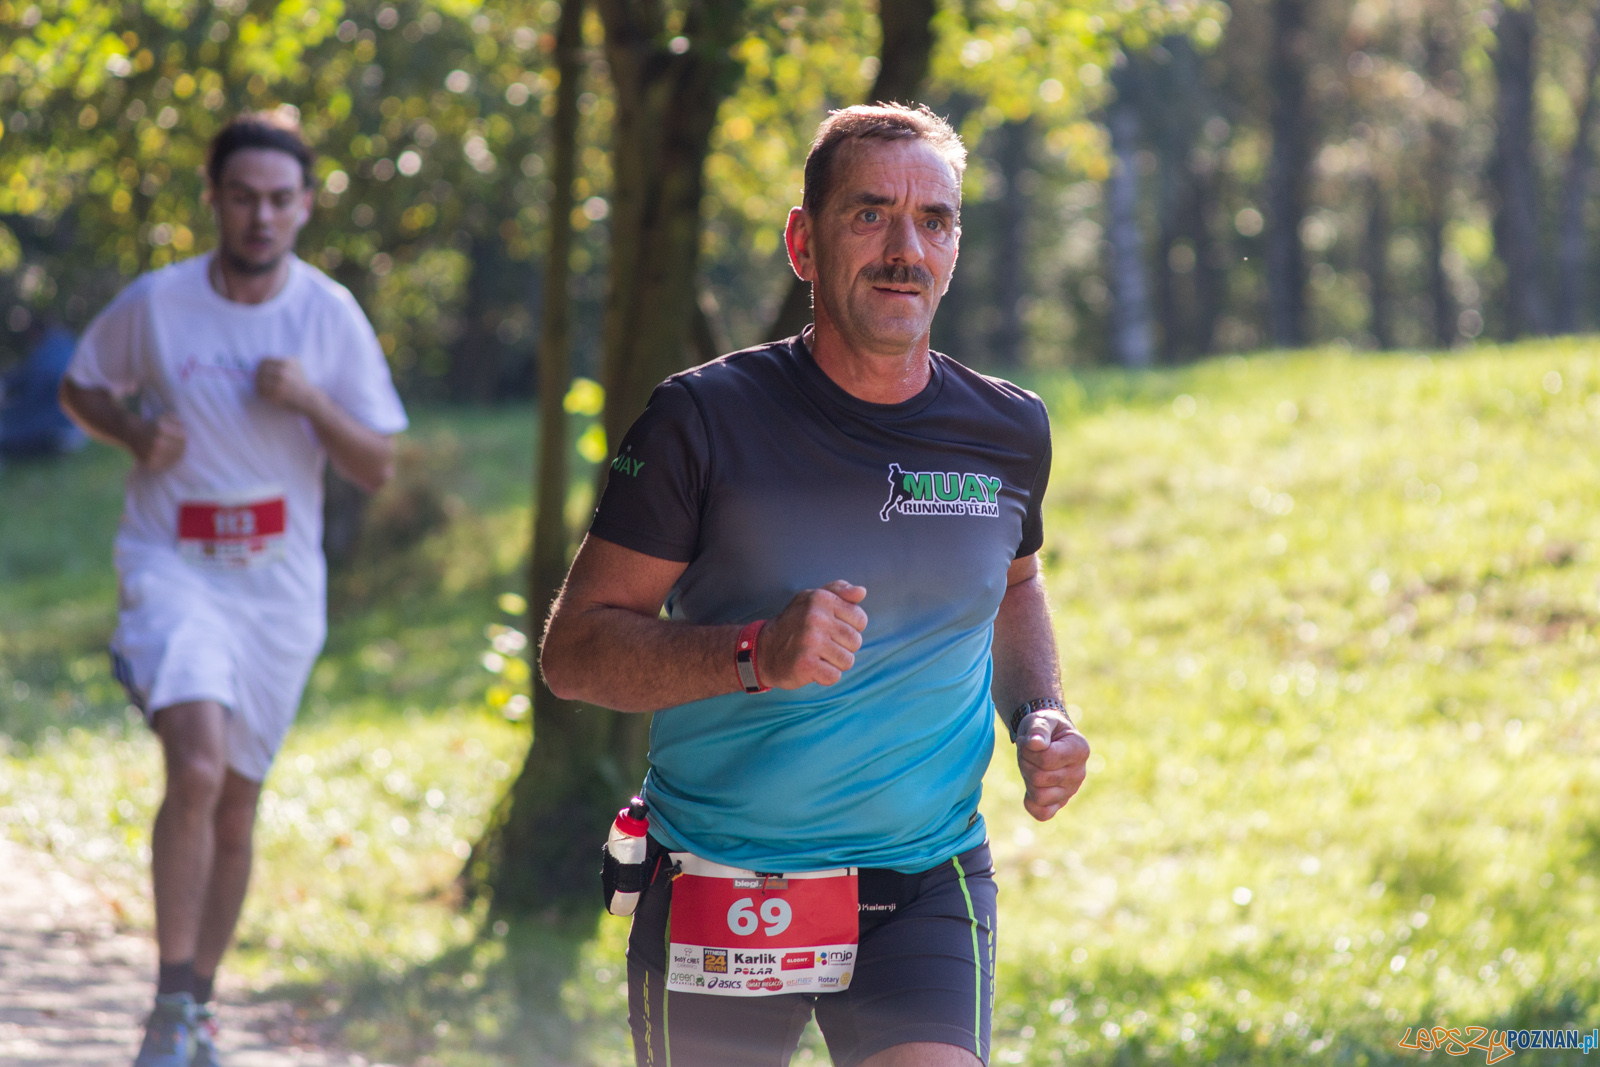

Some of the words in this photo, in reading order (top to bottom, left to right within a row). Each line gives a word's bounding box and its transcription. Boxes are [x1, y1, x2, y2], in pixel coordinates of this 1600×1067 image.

[610, 453, 645, 477] UAY
[902, 472, 1001, 504] MUAY
[903, 502, 965, 514] RUNNING
[967, 503, 999, 516] TEAM
[726, 897, 793, 937] 69
[704, 955, 727, 966] 24
[734, 953, 776, 964] Karlik
[830, 950, 853, 962] mjp
[734, 967, 774, 975] POLAR
[670, 972, 695, 984] green
[718, 979, 742, 989] asics
[818, 976, 840, 984] Rotary
